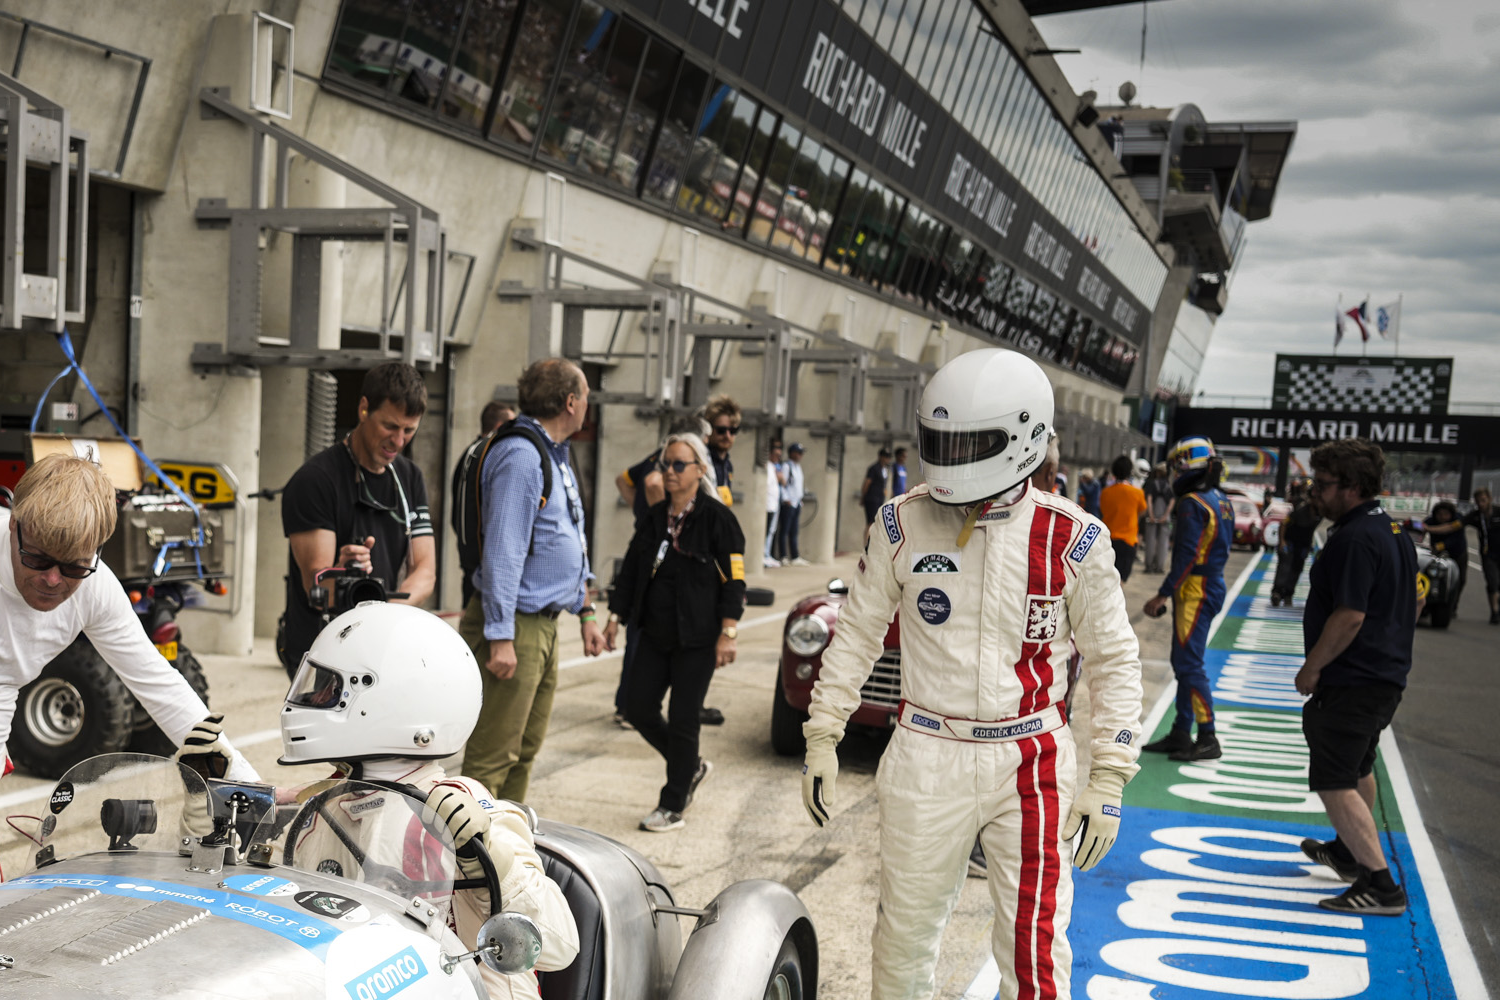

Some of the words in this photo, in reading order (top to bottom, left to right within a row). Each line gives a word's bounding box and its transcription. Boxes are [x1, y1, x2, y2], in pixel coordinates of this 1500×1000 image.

[802, 30, 887, 137] RICHARD
[877, 94, 928, 169] MILLE
[1230, 417, 1359, 442] RICHARD
[1369, 422, 1461, 445] MILLE
[884, 505, 898, 541] sparco
[1072, 525, 1098, 560] sparco
[930, 554, 949, 564] MANS
[913, 716, 939, 729] sparco
[974, 728, 1008, 738] ZDENĚK
[1010, 719, 1042, 736] KAŠPAR
[52, 794, 73, 803] CLASSIC
[224, 902, 300, 926] ROBOT
